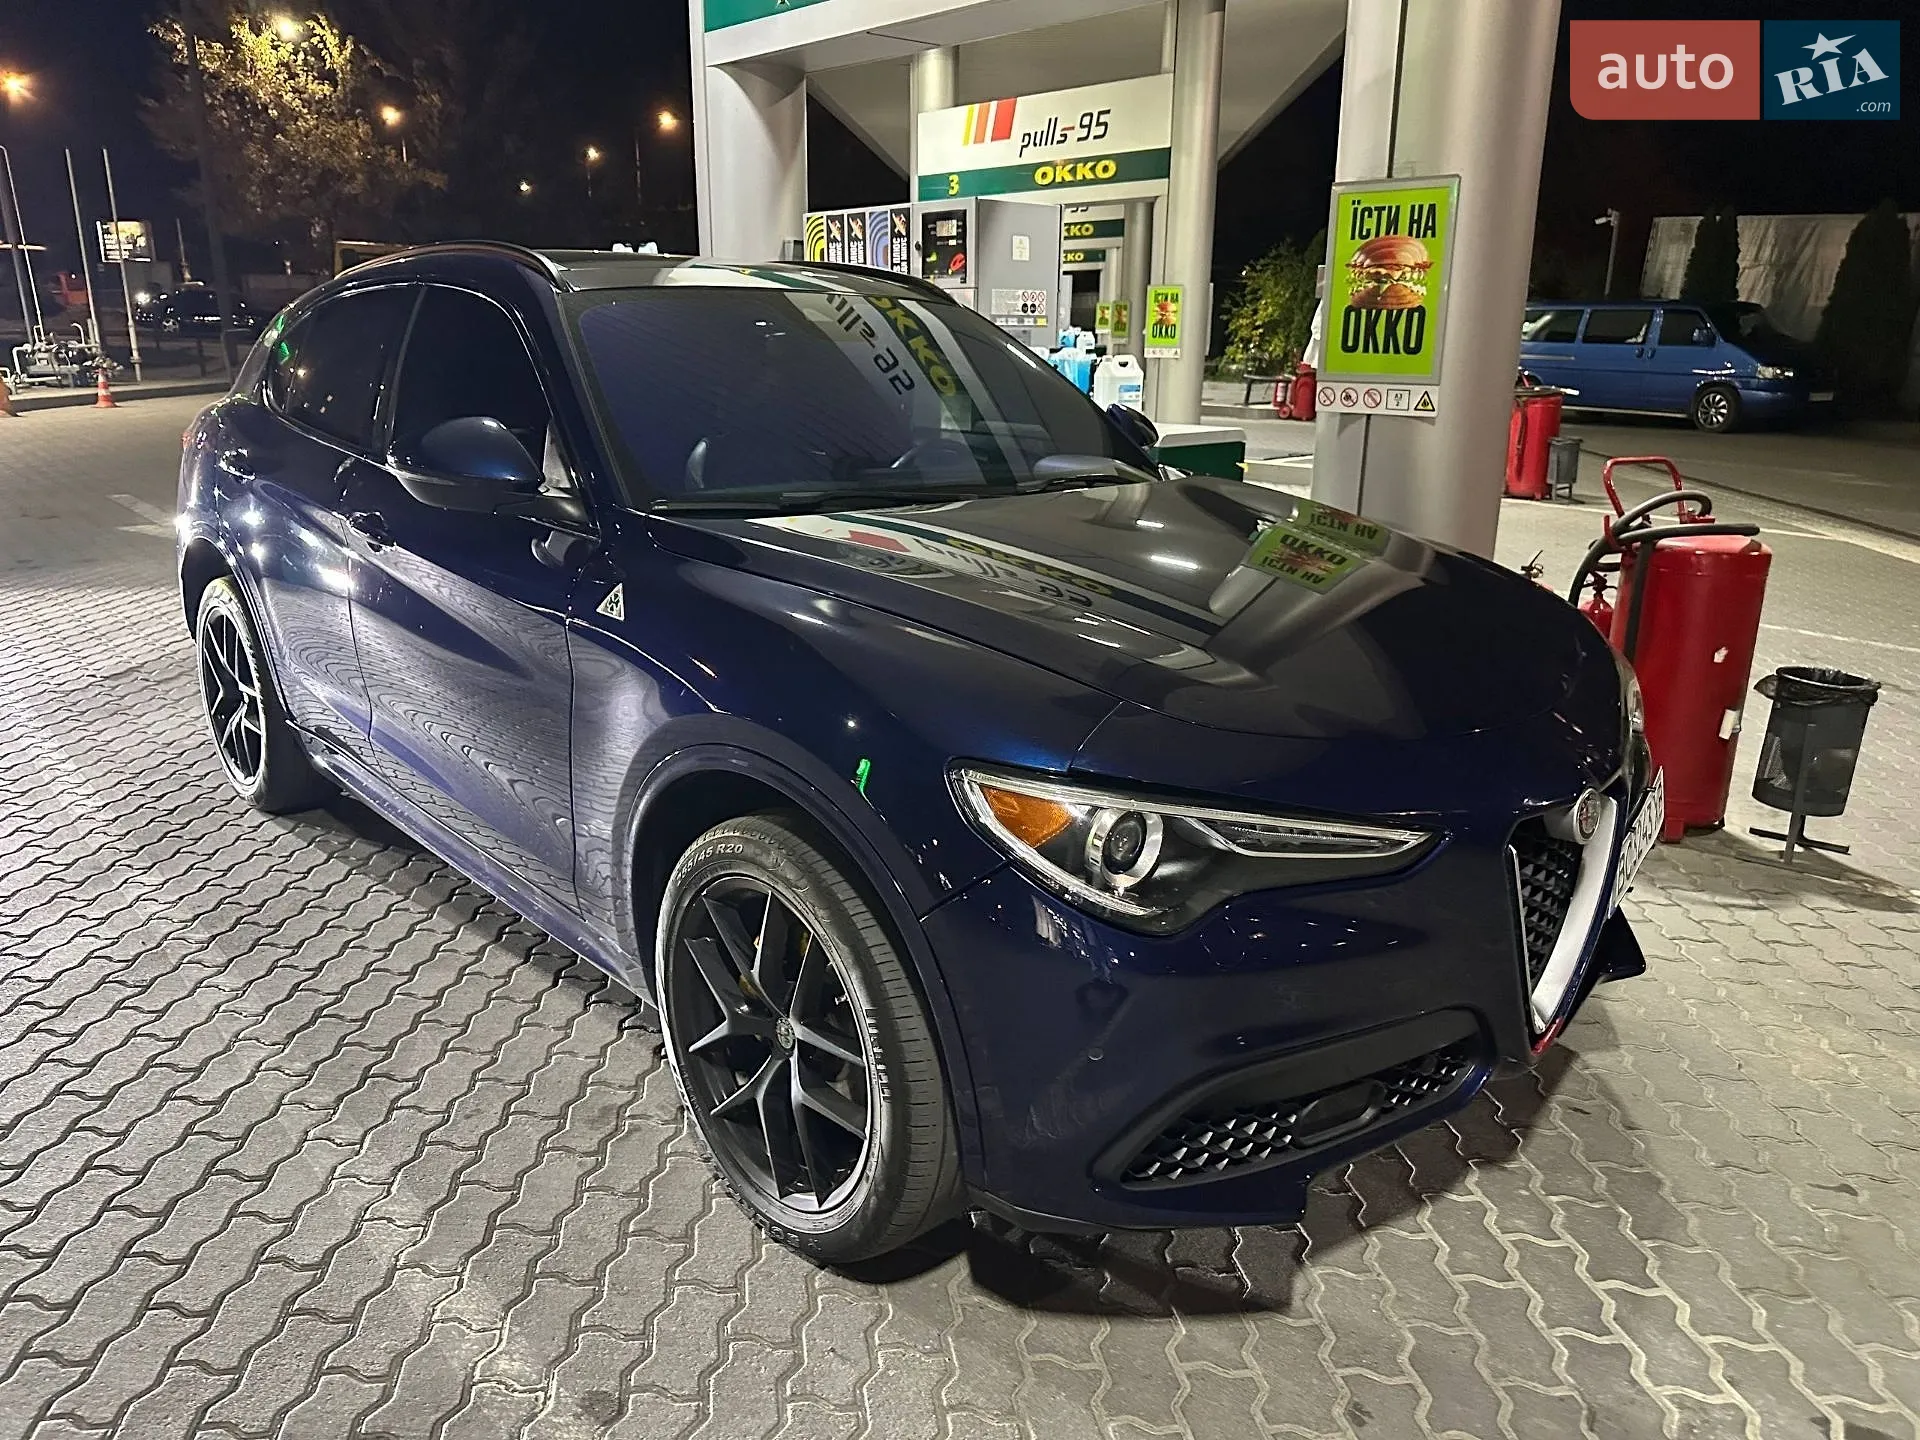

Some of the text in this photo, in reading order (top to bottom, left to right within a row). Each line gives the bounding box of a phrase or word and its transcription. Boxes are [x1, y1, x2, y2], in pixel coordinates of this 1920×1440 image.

[1034, 159, 1117, 186] OKKO
[948, 174, 960, 196] 3
[1350, 200, 1437, 241] ЇСТИ НА
[715, 843, 744, 856] R20
